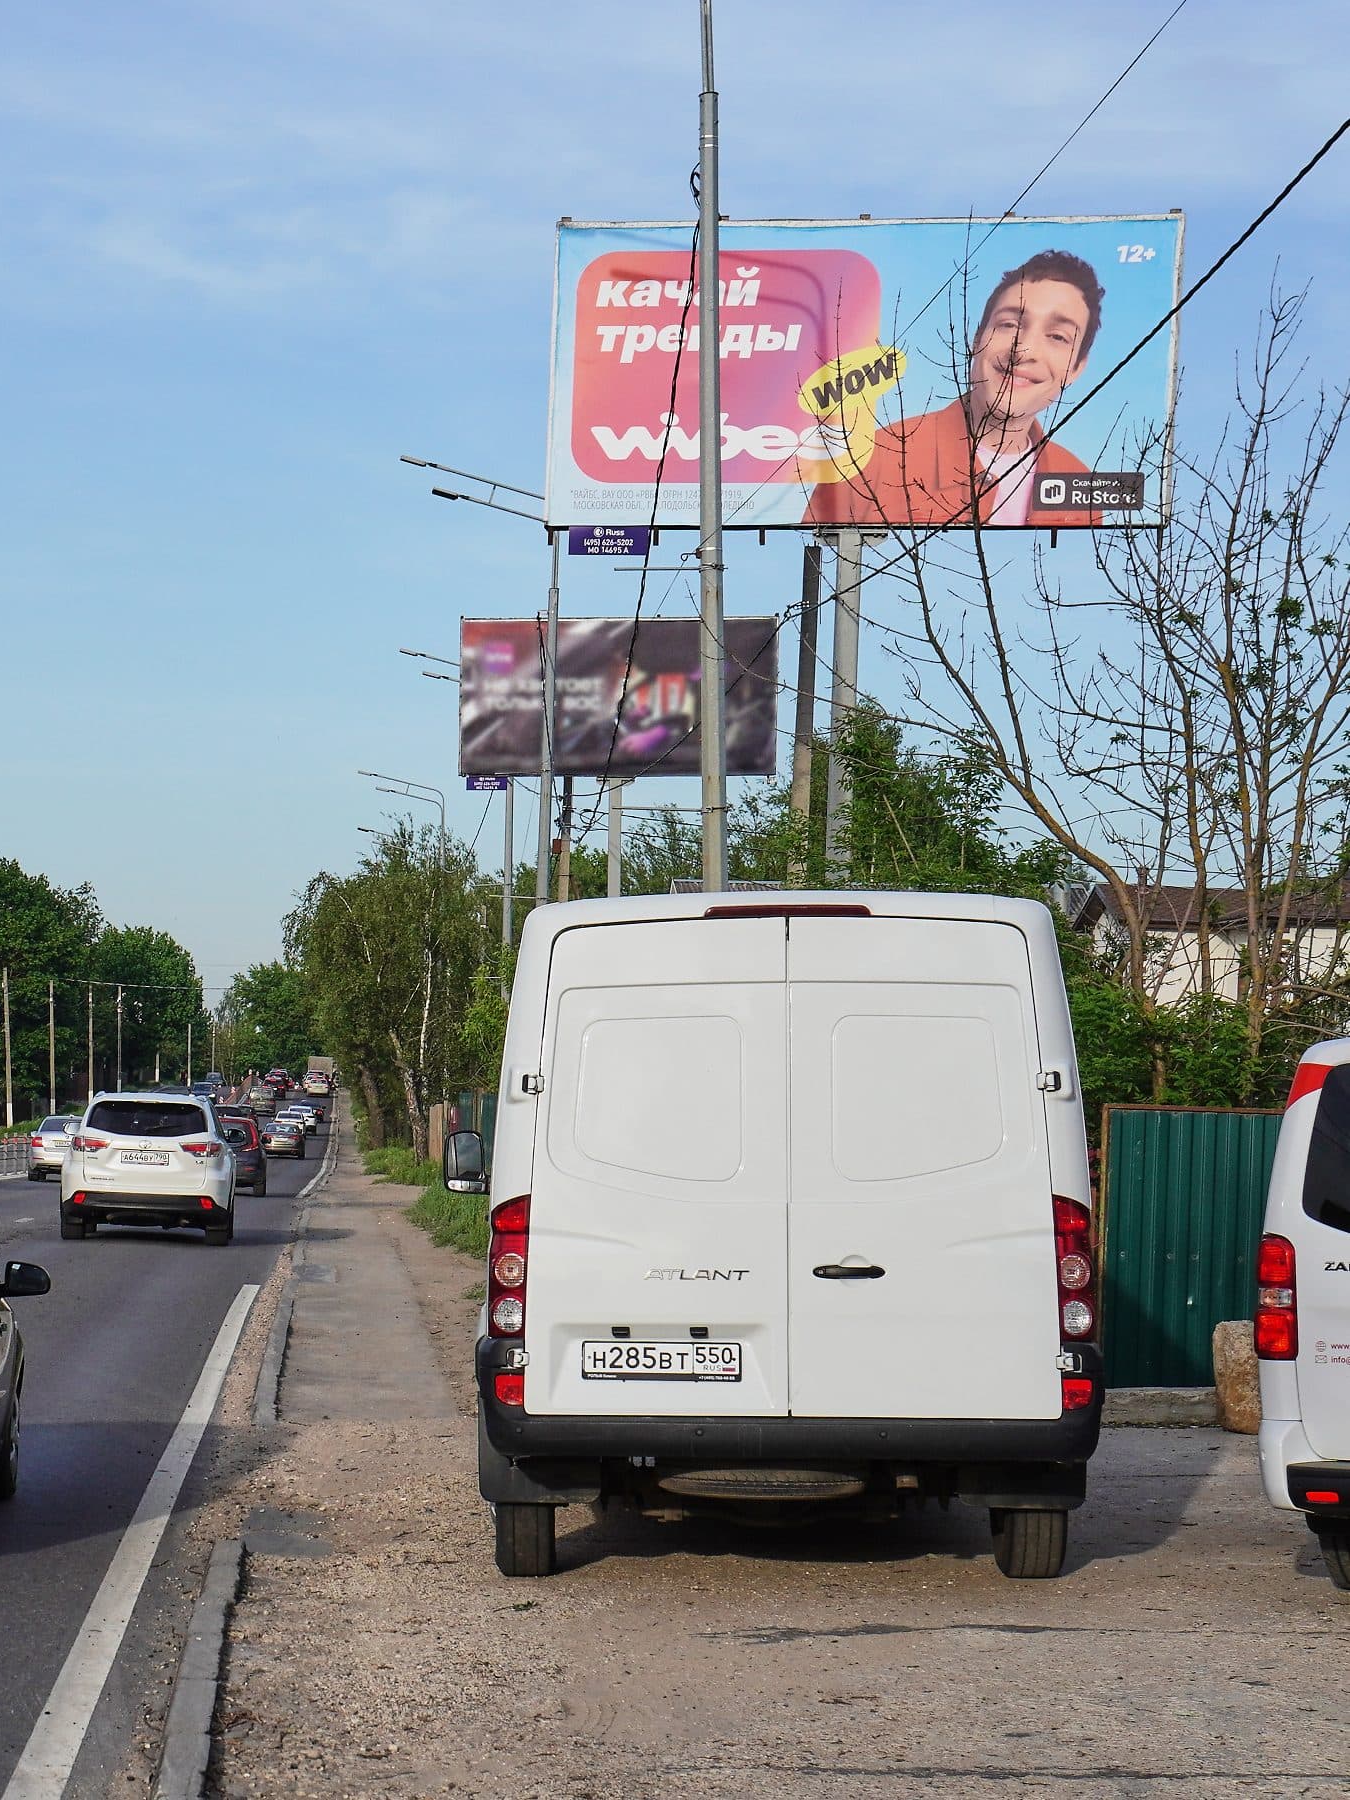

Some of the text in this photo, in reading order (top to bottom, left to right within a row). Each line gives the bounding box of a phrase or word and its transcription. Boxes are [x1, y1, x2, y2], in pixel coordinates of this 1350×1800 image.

[1116, 244, 1156, 263] 12+
[605, 528, 625, 536] Russ
[583, 538, 601, 546] (495)
[1324, 1262, 1350, 1272] ZA
[643, 1269, 750, 1281] ATLANT
[695, 1346, 733, 1364] 550
[703, 1364, 721, 1372] RUS
